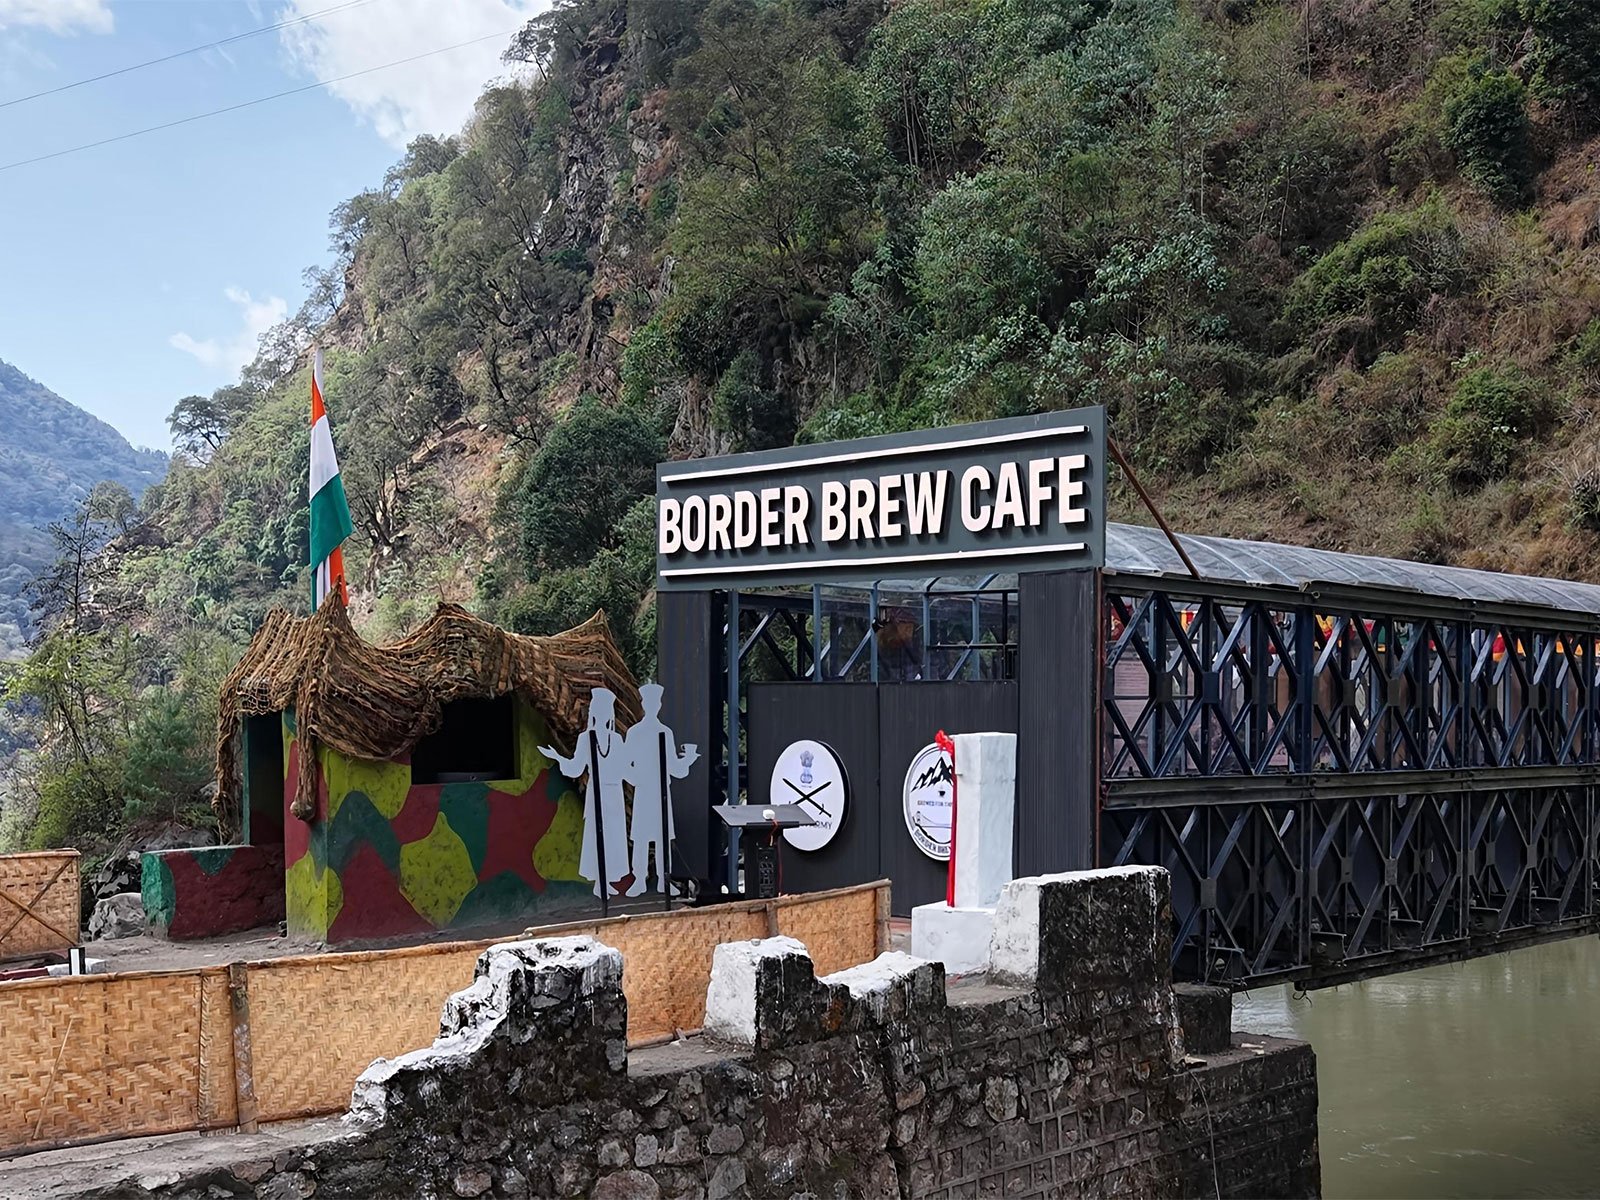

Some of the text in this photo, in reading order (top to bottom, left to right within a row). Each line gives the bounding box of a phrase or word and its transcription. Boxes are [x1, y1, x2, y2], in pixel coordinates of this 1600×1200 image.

[659, 454, 1086, 554] BORDER BREW CAFE
